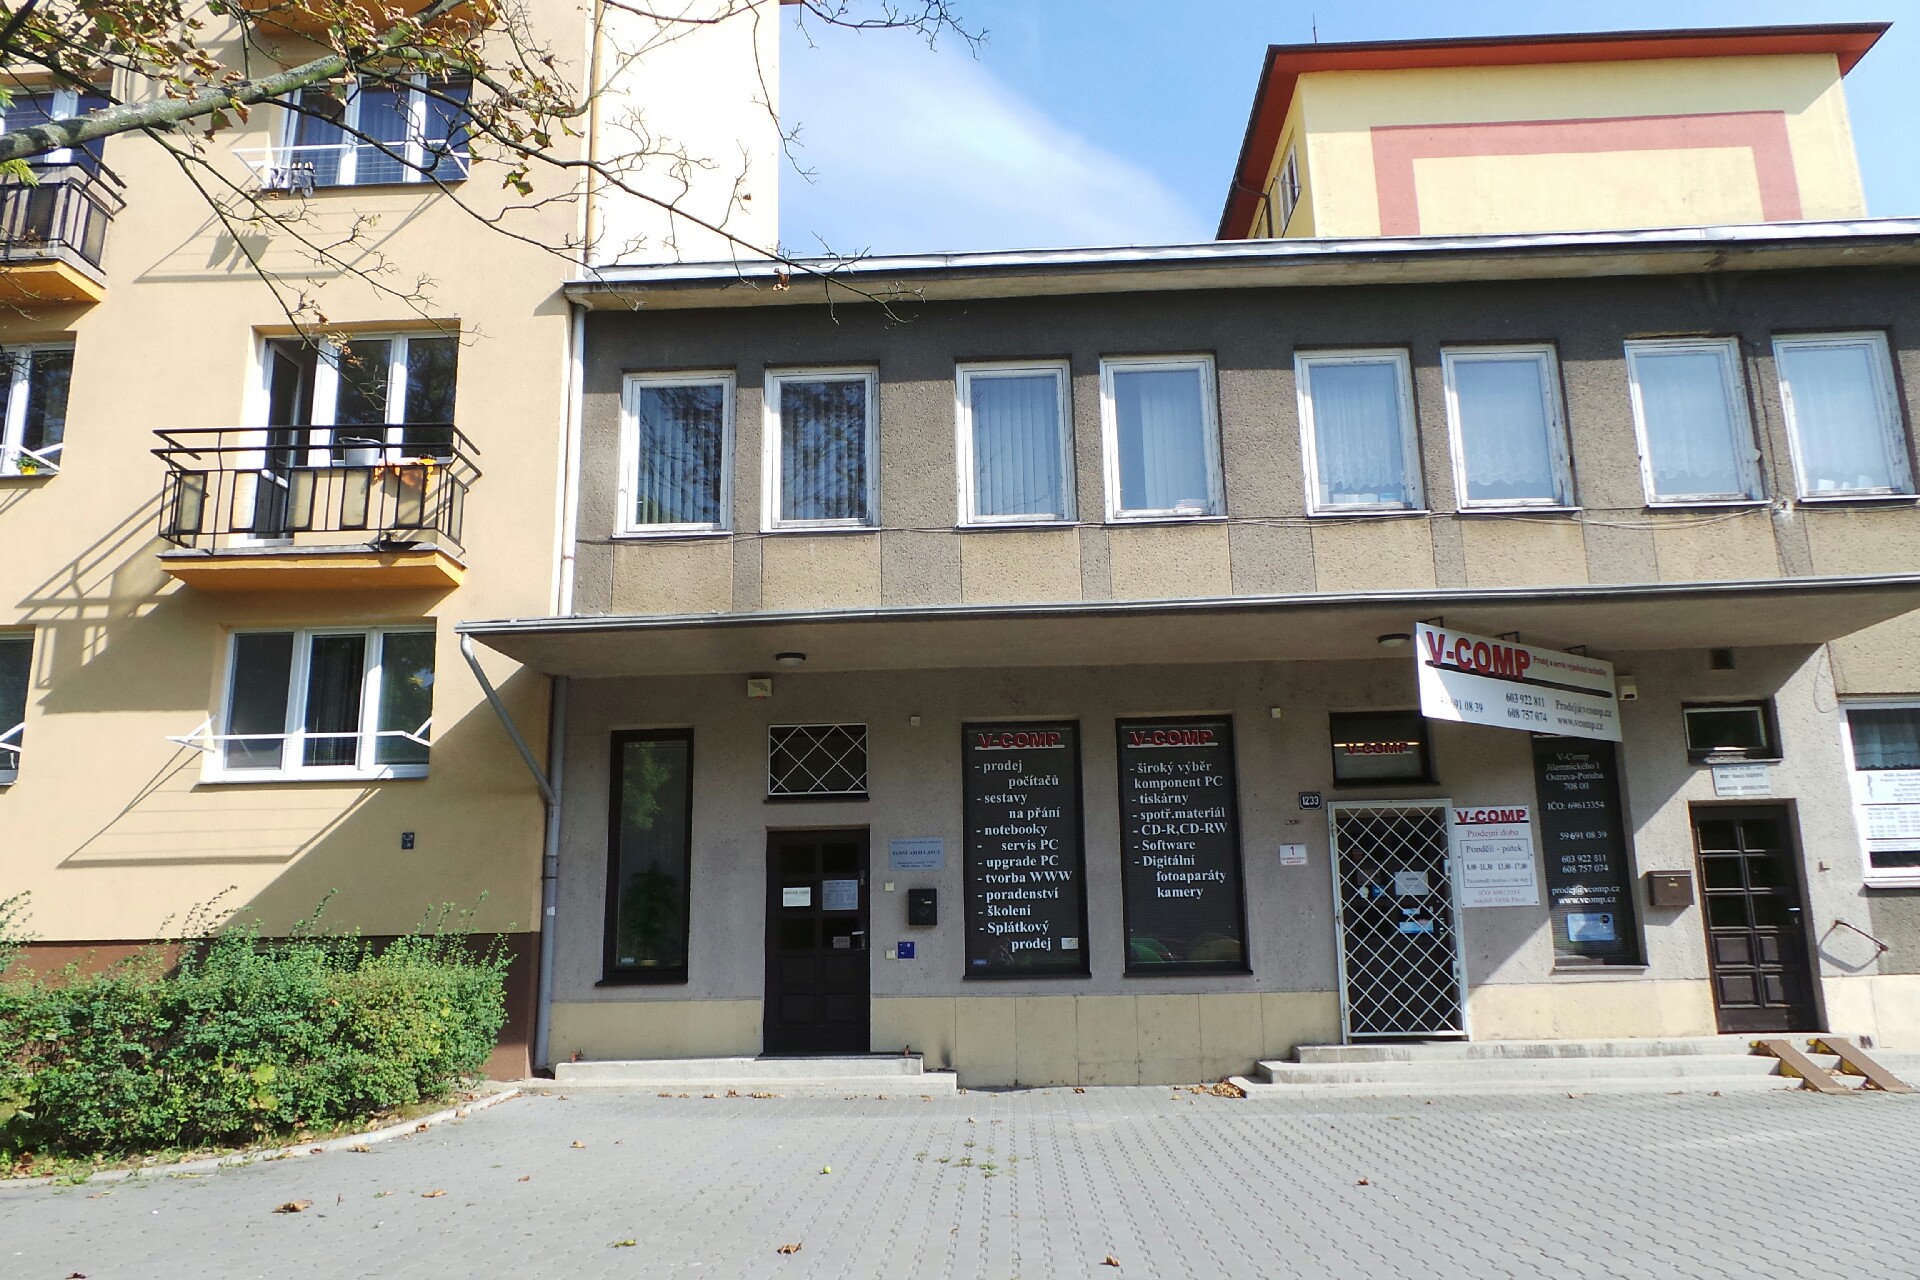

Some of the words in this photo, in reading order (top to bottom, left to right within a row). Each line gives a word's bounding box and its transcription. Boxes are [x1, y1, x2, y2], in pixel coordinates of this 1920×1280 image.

[1425, 631, 1531, 681] V-COMP
[1506, 692, 1518, 703] 603
[1520, 694, 1532, 705] 922
[1534, 696, 1545, 707] 811
[1464, 700, 1473, 711] 08
[1475, 702, 1484, 713] 39
[1507, 708, 1520, 718] 608
[1521, 709, 1533, 720] 757
[1535, 711, 1547, 722] 074
[1557, 717, 1604, 731] www.vcomp.cz
[977, 732, 1061, 748] V-COMP
[1129, 729, 1214, 746] V-COMP
[1346, 742, 1409, 754] V-COMP
[1556, 753, 1589, 761] V-Comp
[983, 760, 1023, 774] prodej
[1137, 761, 1175, 775] široký
[1177, 761, 1212, 774] výběr
[1008, 774, 1059, 788] počítačů
[1546, 772, 1604, 780] Ostrava-Poruba
[1134, 777, 1201, 791] komponent
[1204, 775, 1223, 787] PC
[984, 793, 1028, 806] sestavy
[1139, 792, 1189, 805] tiskárny
[1302, 796, 1319, 805] 1233
[1547, 802, 1566, 810] IČO:
[1567, 801, 1605, 809] 69613354
[1008, 810, 1024, 820] na
[1027, 807, 1061, 822] přání
[1140, 807, 1226, 822] spotř.materiál
[1456, 809, 1526, 824] V-COMP
[984, 824, 1048, 837] notebooky
[1141, 822, 1228, 836] CD-R,CD-RW
[1467, 829, 1498, 838] Prodejní
[1586, 831, 1596, 839] 08
[1001, 840, 1036, 851] servis
[1040, 839, 1059, 850] PC
[1142, 839, 1196, 851] Software
[1290, 846, 1295, 855] 1
[1502, 845, 1523, 853] pátek
[986, 856, 1037, 870] upgrade
[1040, 855, 1059, 866] PC
[1142, 855, 1195, 869] Digitální
[1561, 855, 1575, 863] 603
[1578, 855, 1591, 863] 922
[1594, 854, 1606, 862] 811
[1562, 865, 1577, 873] 608
[1578, 865, 1592, 873] 757
[1594, 864, 1609, 872] 074
[985, 872, 1026, 883] tvorba
[1029, 871, 1073, 882] WWW
[1156, 870, 1227, 883] fotoaparáty
[986, 886, 1059, 902] poradenství
[1157, 886, 1204, 899] kamery
[1552, 884, 1620, 895] prodej@vcomp.cz
[987, 904, 1031, 917] školení
[987, 920, 1050, 935] Splátkový
[1011, 937, 1051, 951] prodej
